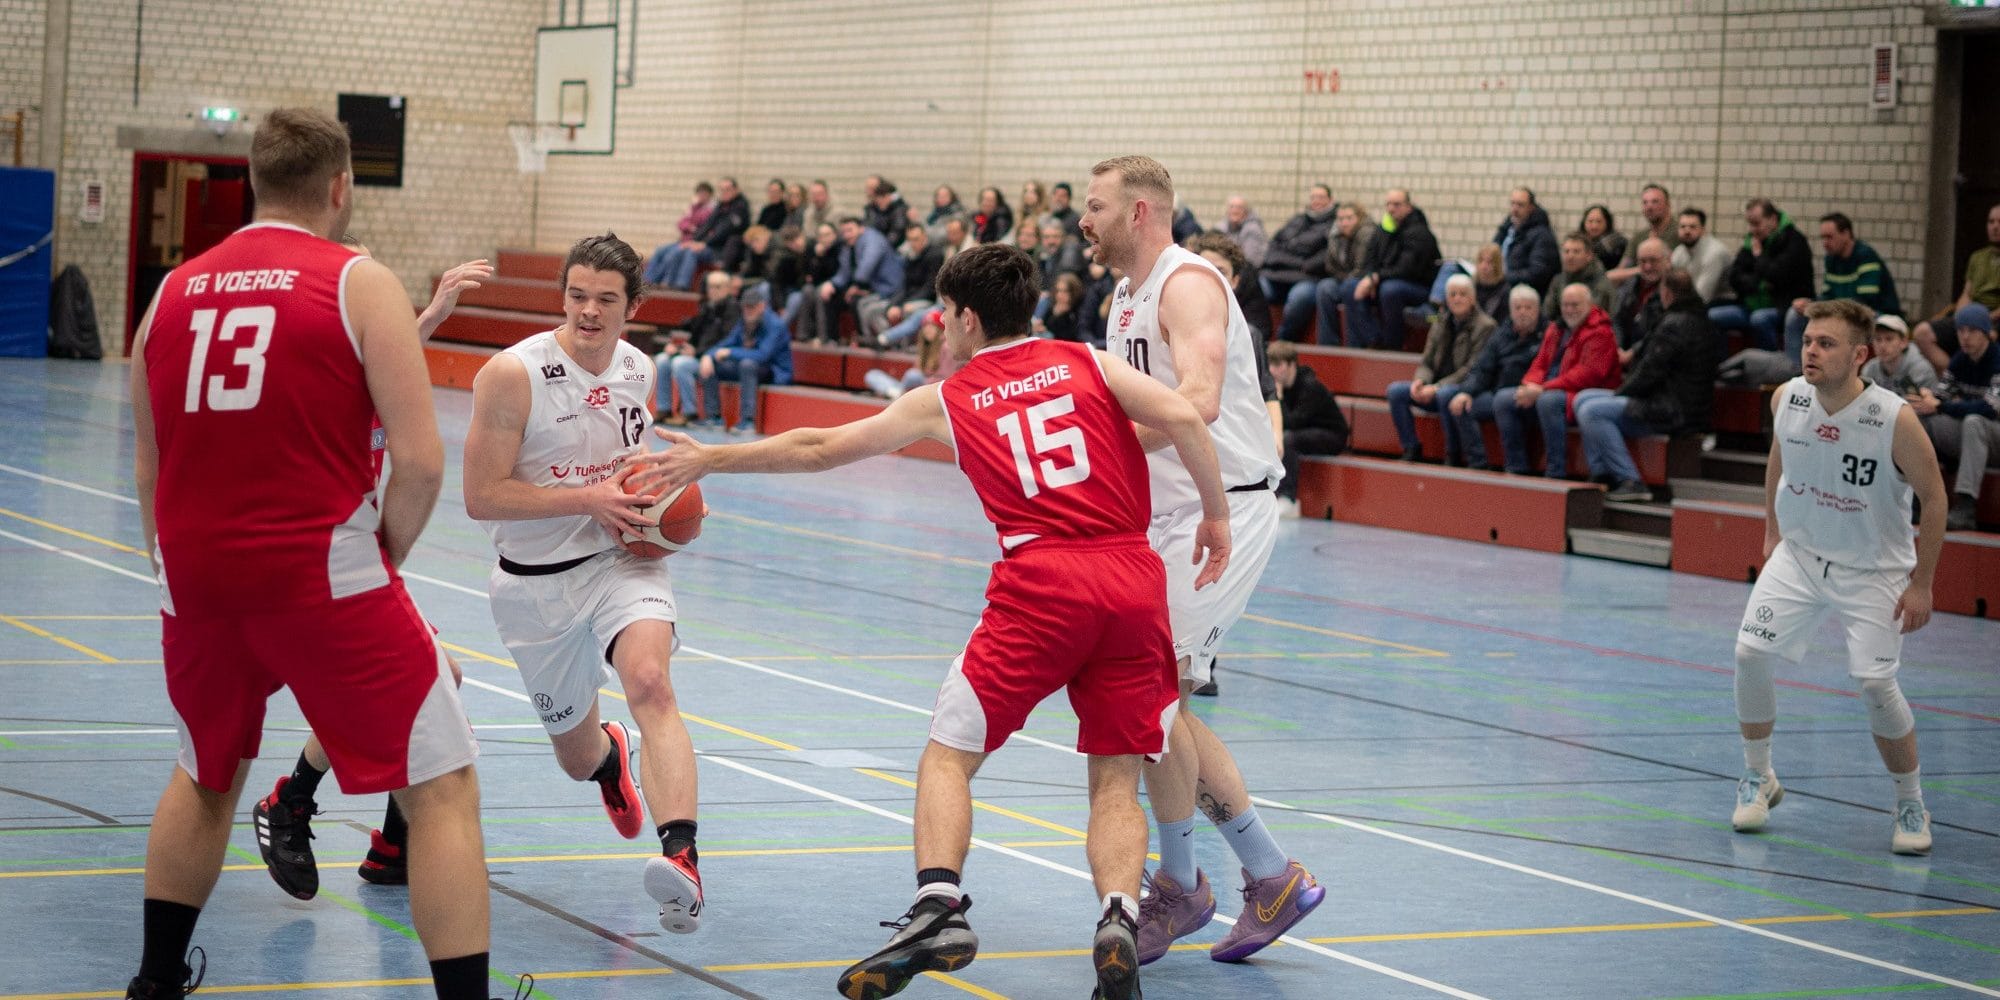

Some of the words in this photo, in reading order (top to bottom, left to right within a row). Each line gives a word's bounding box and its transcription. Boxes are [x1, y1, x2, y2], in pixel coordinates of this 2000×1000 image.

[184, 273, 211, 297] TG
[214, 268, 300, 293] VOERDE
[184, 305, 277, 413] 13
[970, 387, 995, 411] TG
[997, 364, 1072, 400] VOERDE
[556, 414, 579, 423] CRAFT
[619, 407, 645, 447] 13
[995, 393, 1091, 499] 15
[1842, 453, 1878, 487] 33
[641, 597, 669, 607] CRAFT
[1743, 622, 1777, 642] wicke
